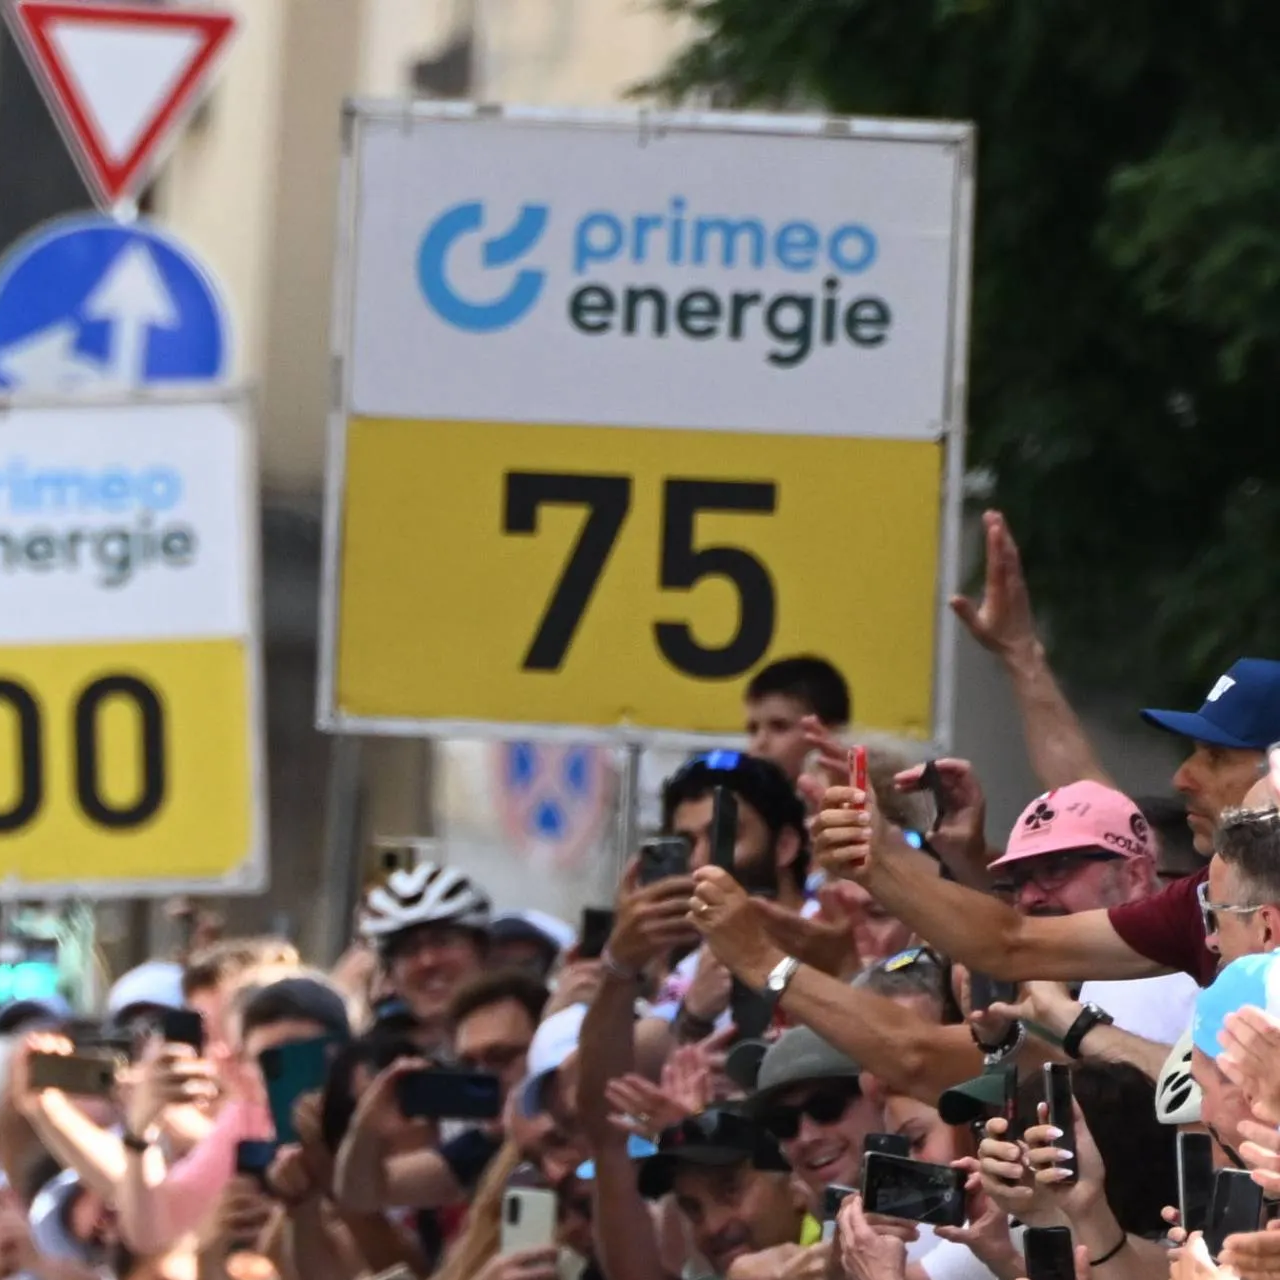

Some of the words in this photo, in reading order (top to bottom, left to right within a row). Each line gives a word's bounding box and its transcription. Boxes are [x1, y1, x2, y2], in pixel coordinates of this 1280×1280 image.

[572, 195, 878, 276] primeo
[567, 277, 893, 369] energie
[501, 468, 779, 682] 75
